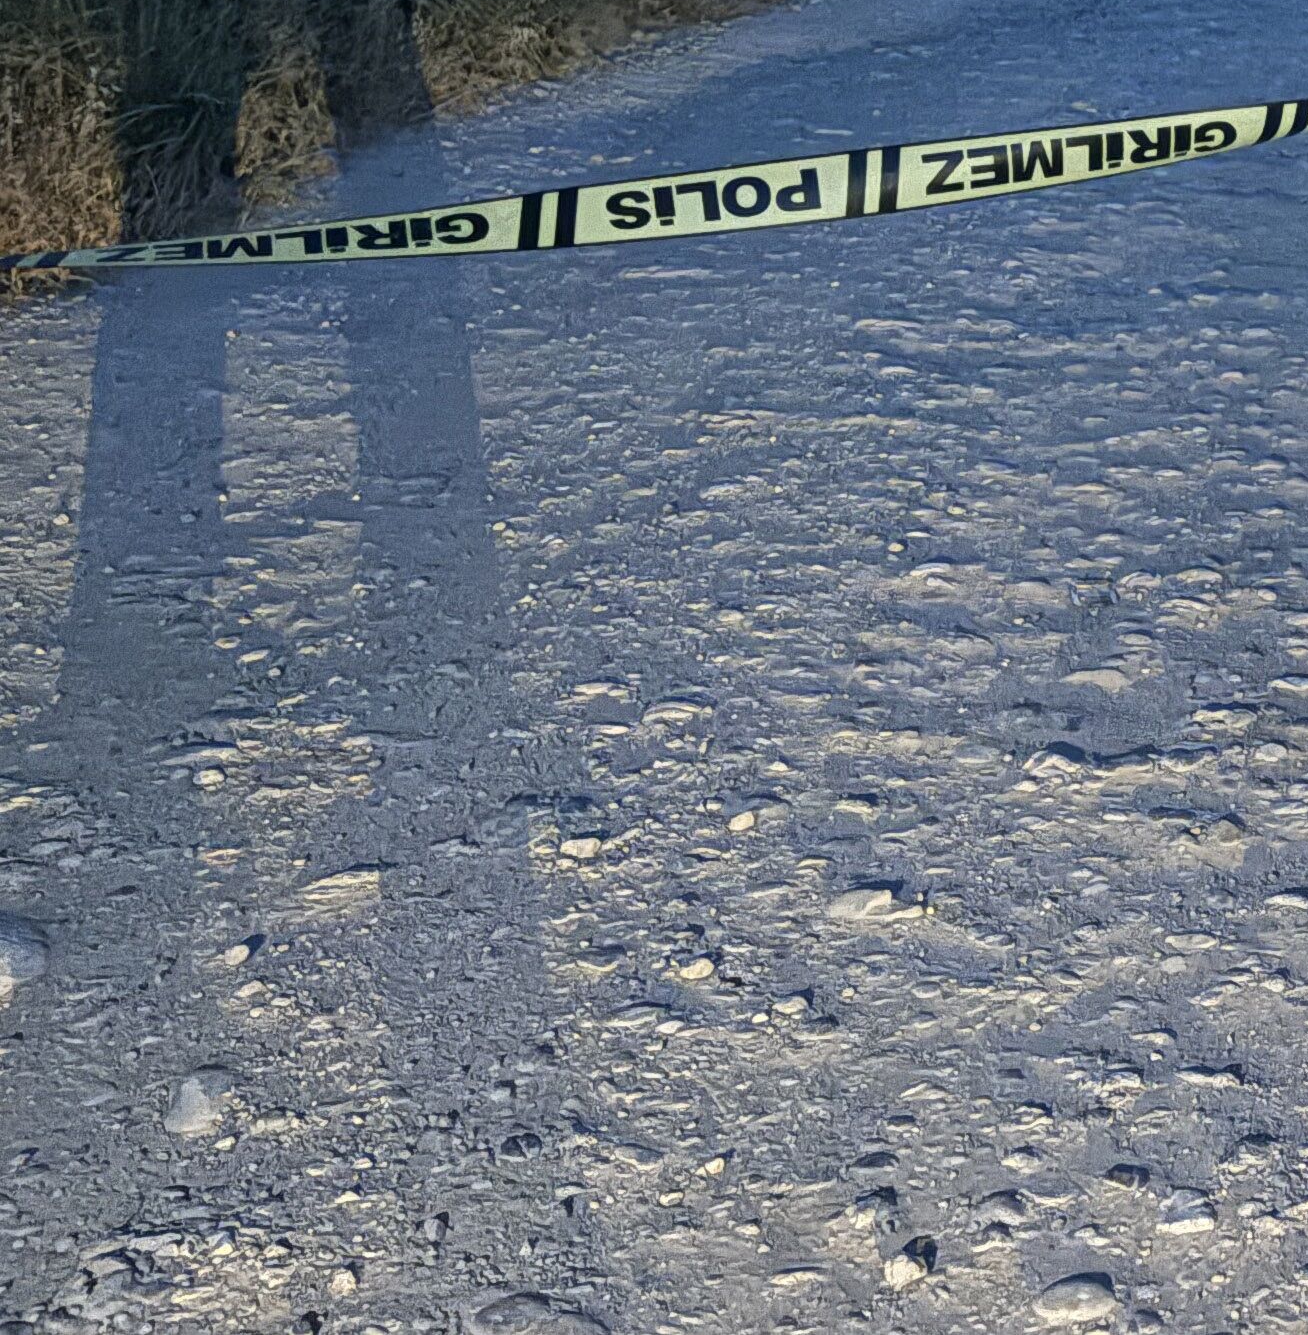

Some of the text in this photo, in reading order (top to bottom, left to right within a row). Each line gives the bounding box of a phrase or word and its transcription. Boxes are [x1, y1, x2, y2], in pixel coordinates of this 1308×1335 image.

[921, 117, 1238, 196] GİRİLMEZ
[606, 167, 822, 230] POLİS
[96, 212, 490, 262] GİRİLMEZ
